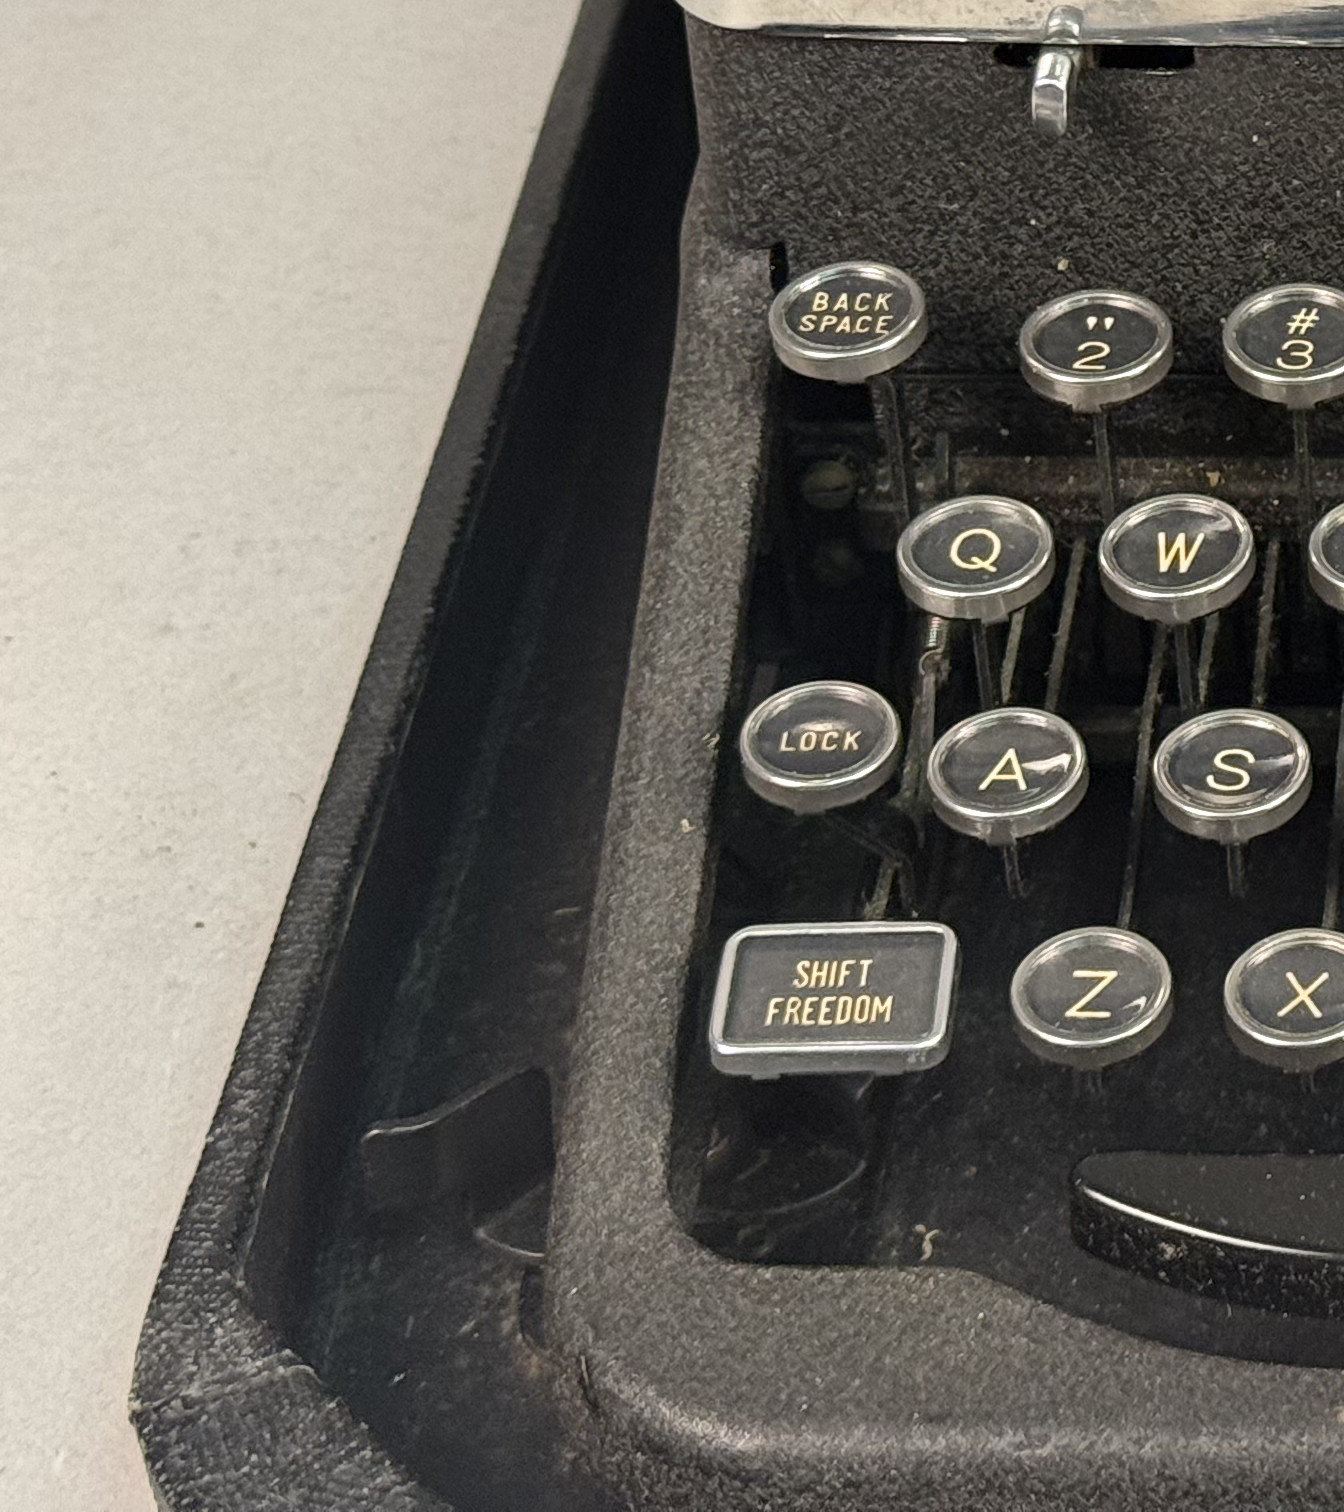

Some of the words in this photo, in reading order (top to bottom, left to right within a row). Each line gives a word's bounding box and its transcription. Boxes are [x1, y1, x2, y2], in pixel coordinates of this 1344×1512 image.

[811, 291, 893, 312] BACK
[799, 314, 894, 335] SPACE
[1286, 307, 1320, 335] #
[1072, 341, 1111, 370] 2
[1276, 339, 1314, 370] 3
[949, 528, 1002, 573] Q
[1157, 531, 1205, 574] W
[780, 727, 861, 752] LOCK
[978, 747, 1023, 791] A
[1206, 748, 1256, 791] S
[792, 959, 873, 989] SHIFT
[1064, 969, 1119, 1019] Z
[1277, 971, 1330, 1018] X
[764, 994, 894, 1026] FREEDOM
